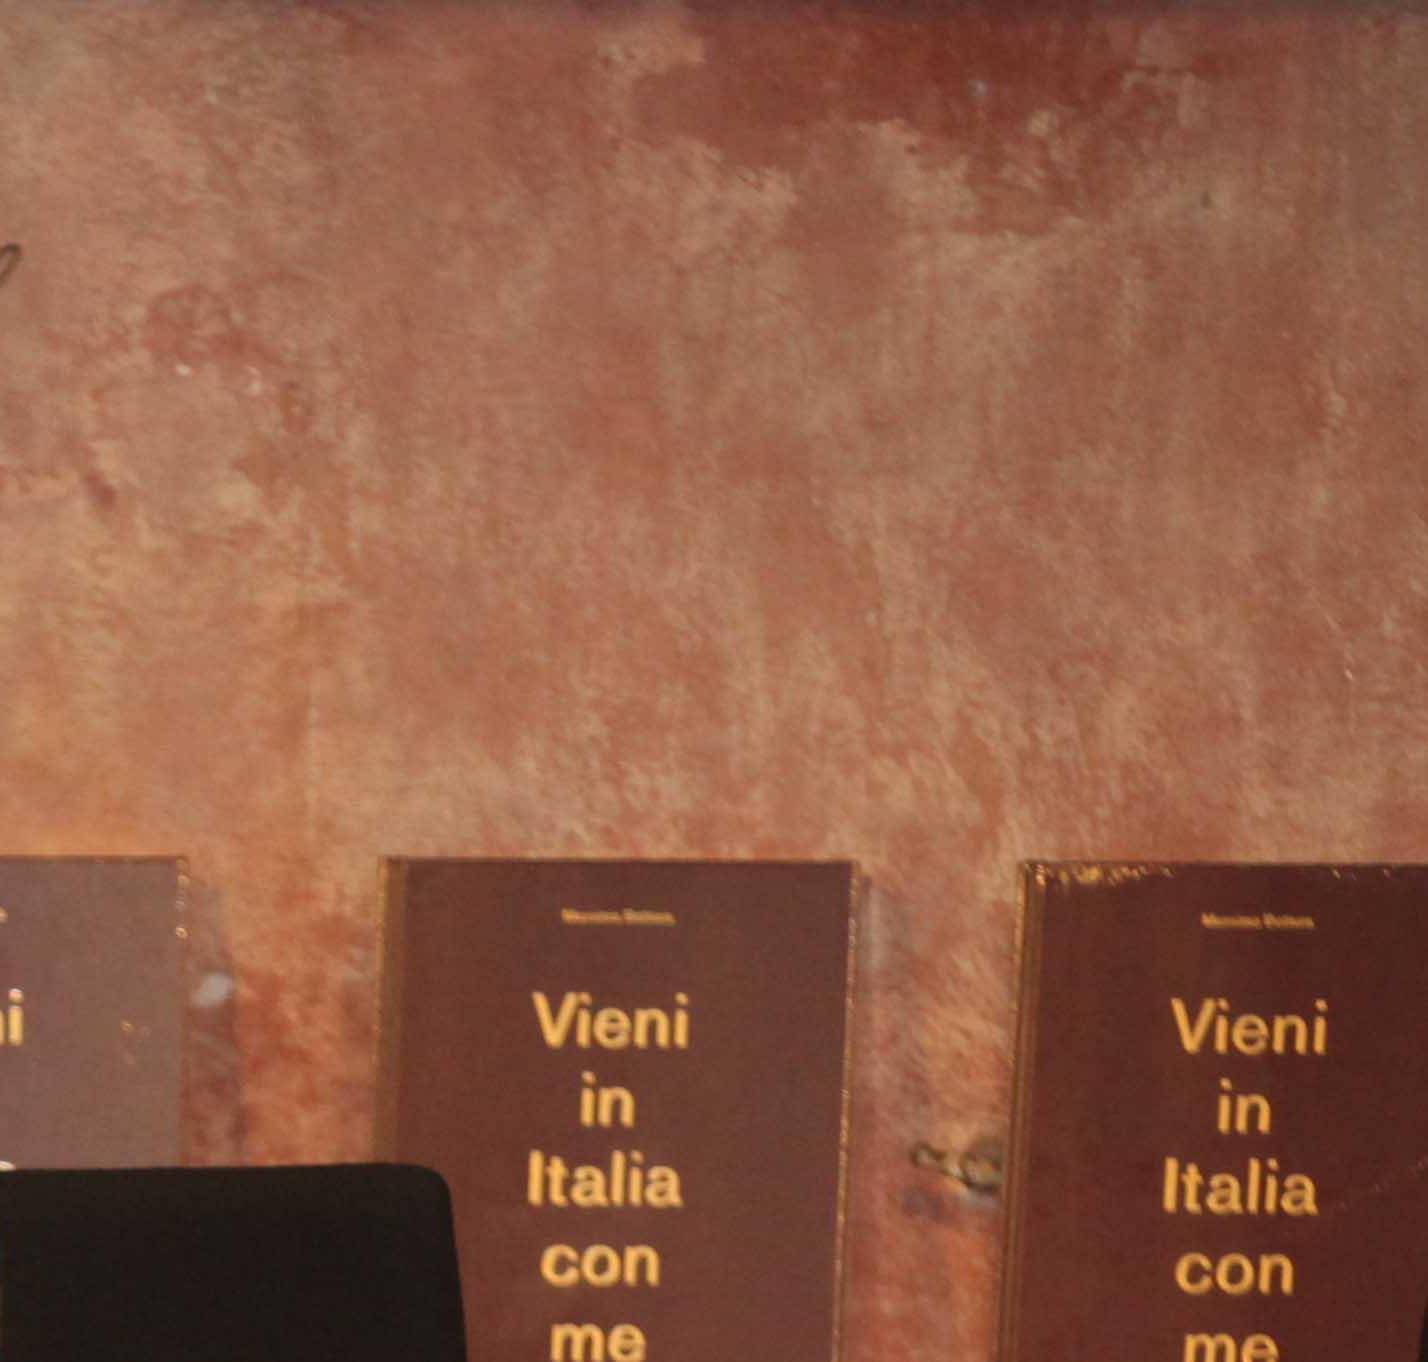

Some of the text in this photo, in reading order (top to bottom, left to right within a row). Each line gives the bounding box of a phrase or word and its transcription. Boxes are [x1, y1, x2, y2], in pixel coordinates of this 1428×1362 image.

[532, 991, 689, 1049] Vieni
[1171, 997, 1327, 1055] Vieni
[580, 1071, 635, 1127] in
[1217, 1077, 1271, 1134] in
[528, 1150, 683, 1207] Italia
[1163, 1157, 1318, 1215] Italia
[541, 1244, 659, 1287] con
[1175, 1252, 1293, 1294] con
